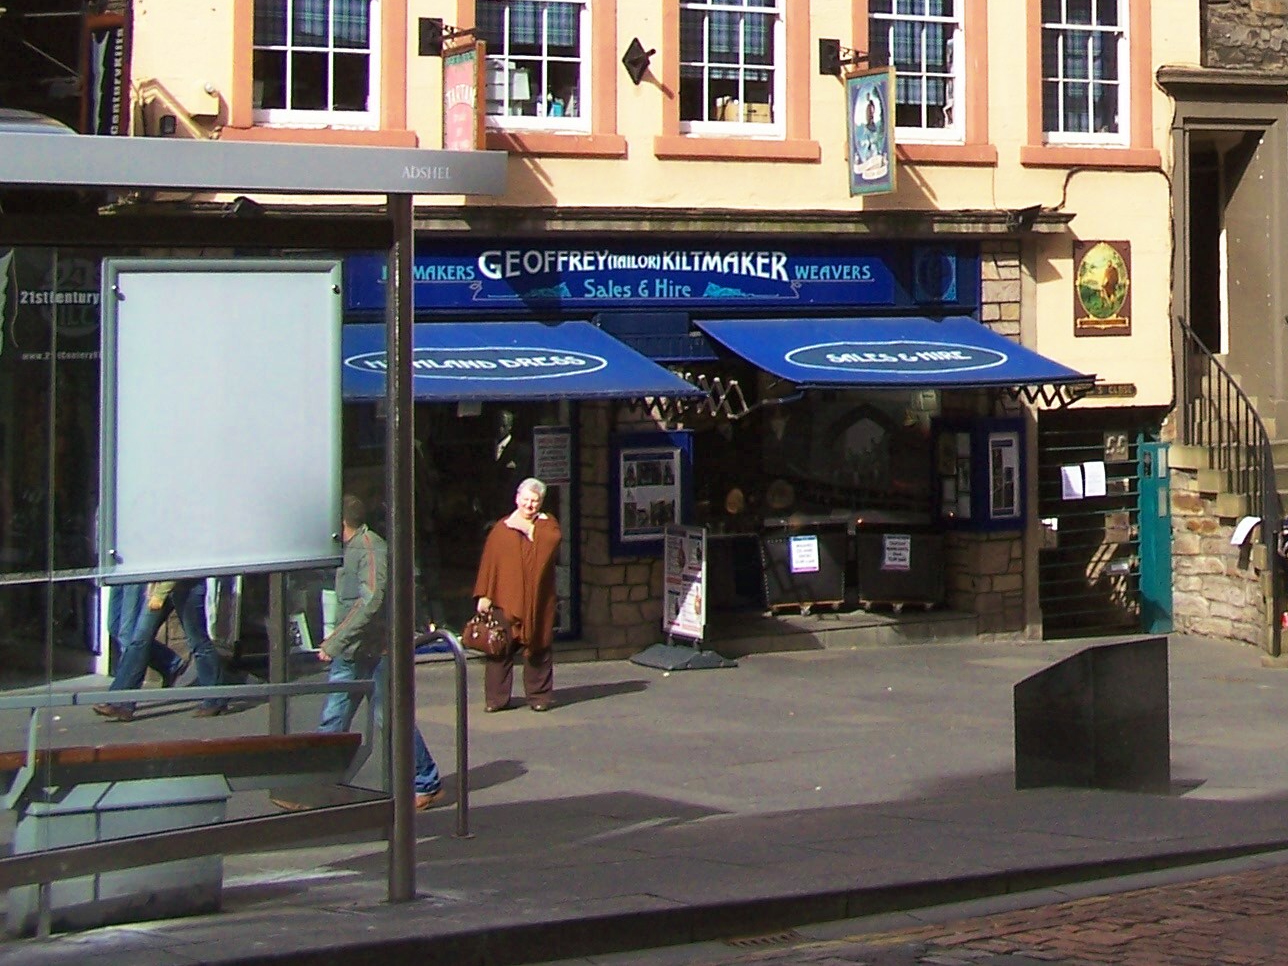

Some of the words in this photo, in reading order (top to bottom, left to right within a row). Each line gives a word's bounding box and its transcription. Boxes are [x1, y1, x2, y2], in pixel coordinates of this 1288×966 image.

[401, 165, 452, 180] ADSHEL
[478, 249, 608, 280] GEOFFREY
[608, 253, 662, 271] (TAILOR)
[662, 250, 790, 282] KILTMAKER
[794, 264, 872, 281] WEAVERS
[583, 278, 632, 299] Sales
[654, 278, 692, 298] Hire
[363, 356, 498, 370] HHLAND
[496, 355, 586, 369] DRESS
[826, 353, 898, 364] SALES
[916, 350, 973, 362] HIRE
